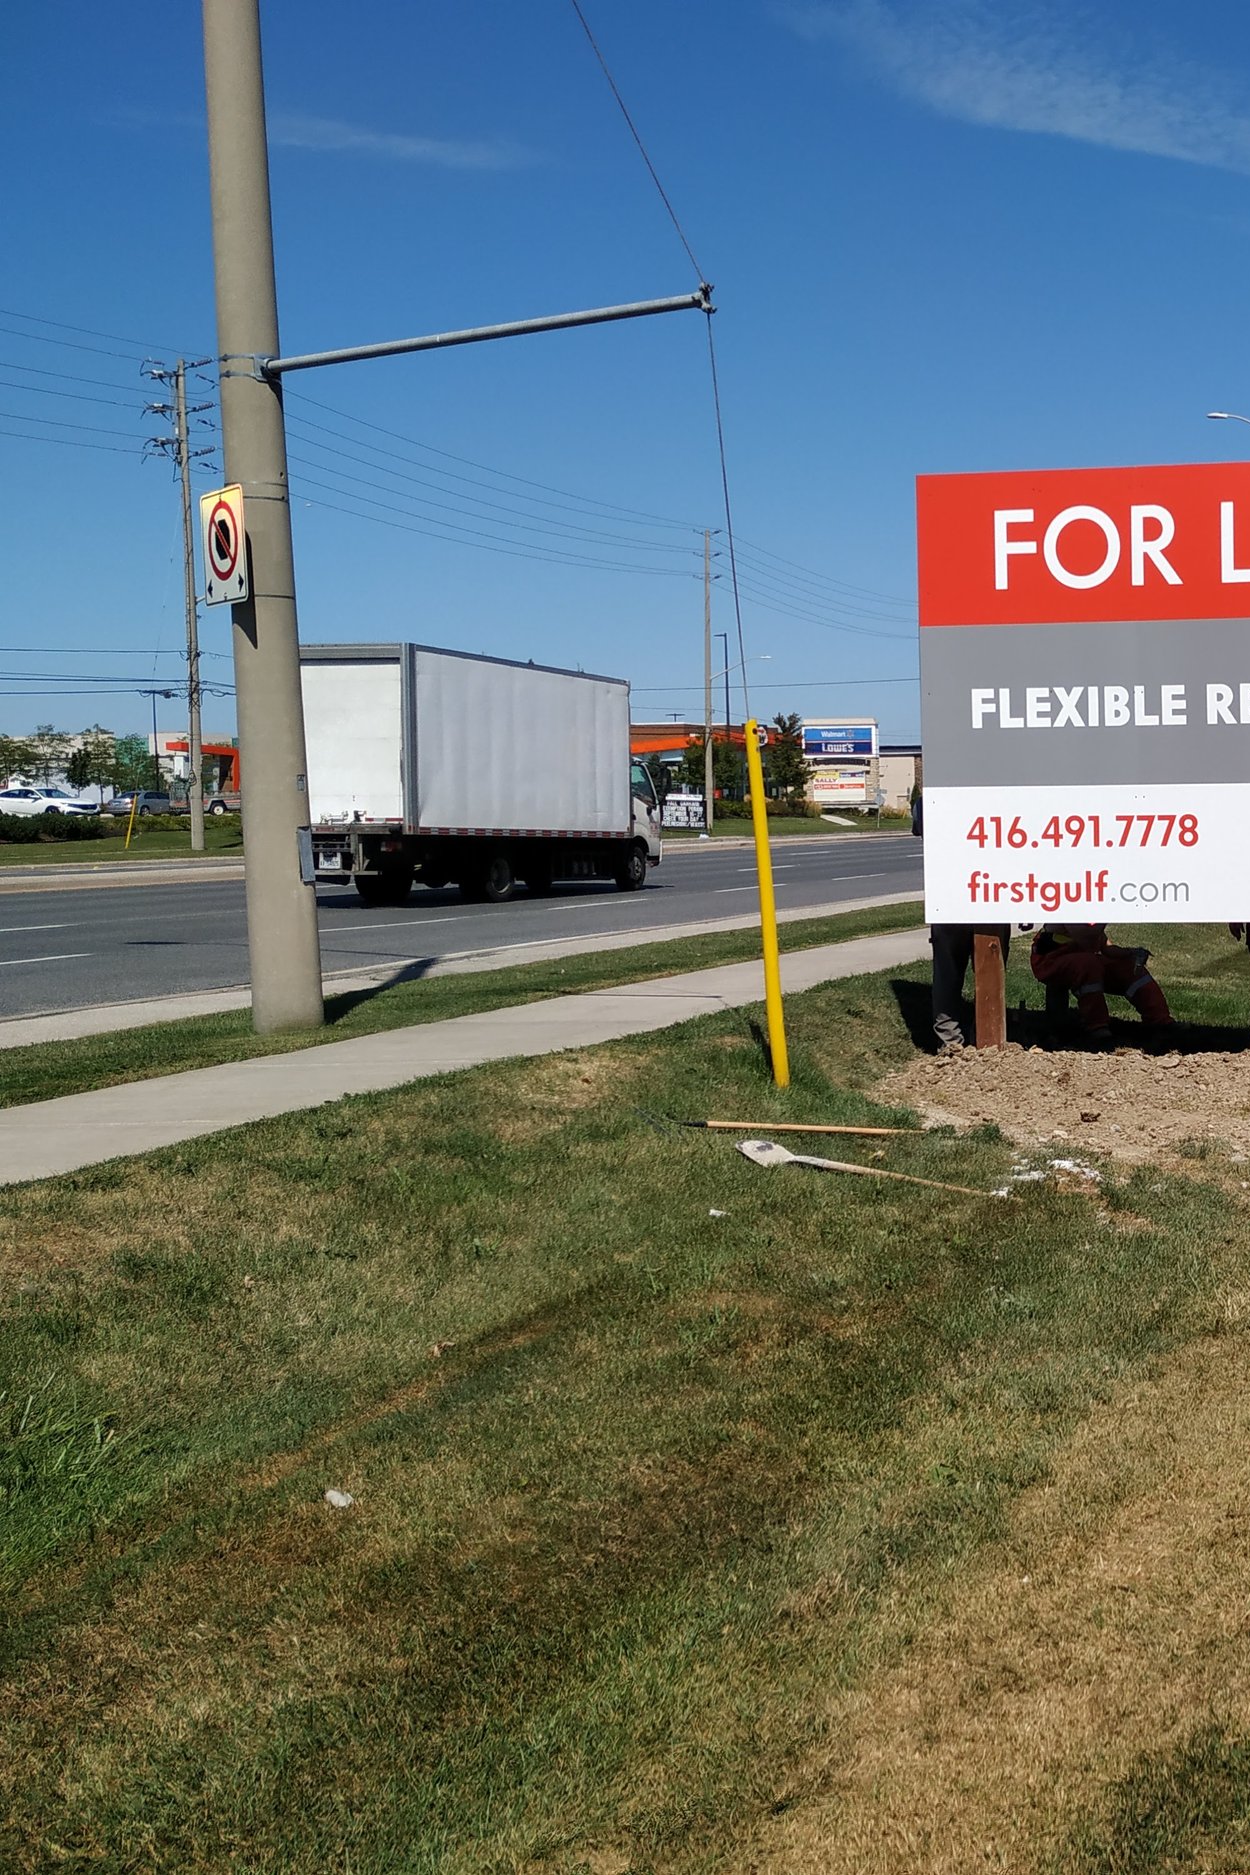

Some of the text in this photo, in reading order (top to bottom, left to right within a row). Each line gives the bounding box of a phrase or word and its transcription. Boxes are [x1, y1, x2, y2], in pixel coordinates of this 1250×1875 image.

[993, 504, 1183, 590] FOR
[971, 684, 1187, 729] FLEXIBLE
[822, 743, 855, 752] LOWE'S
[966, 813, 1199, 849] 416.491.7778
[967, 869, 1189, 913] firstgulf.com
